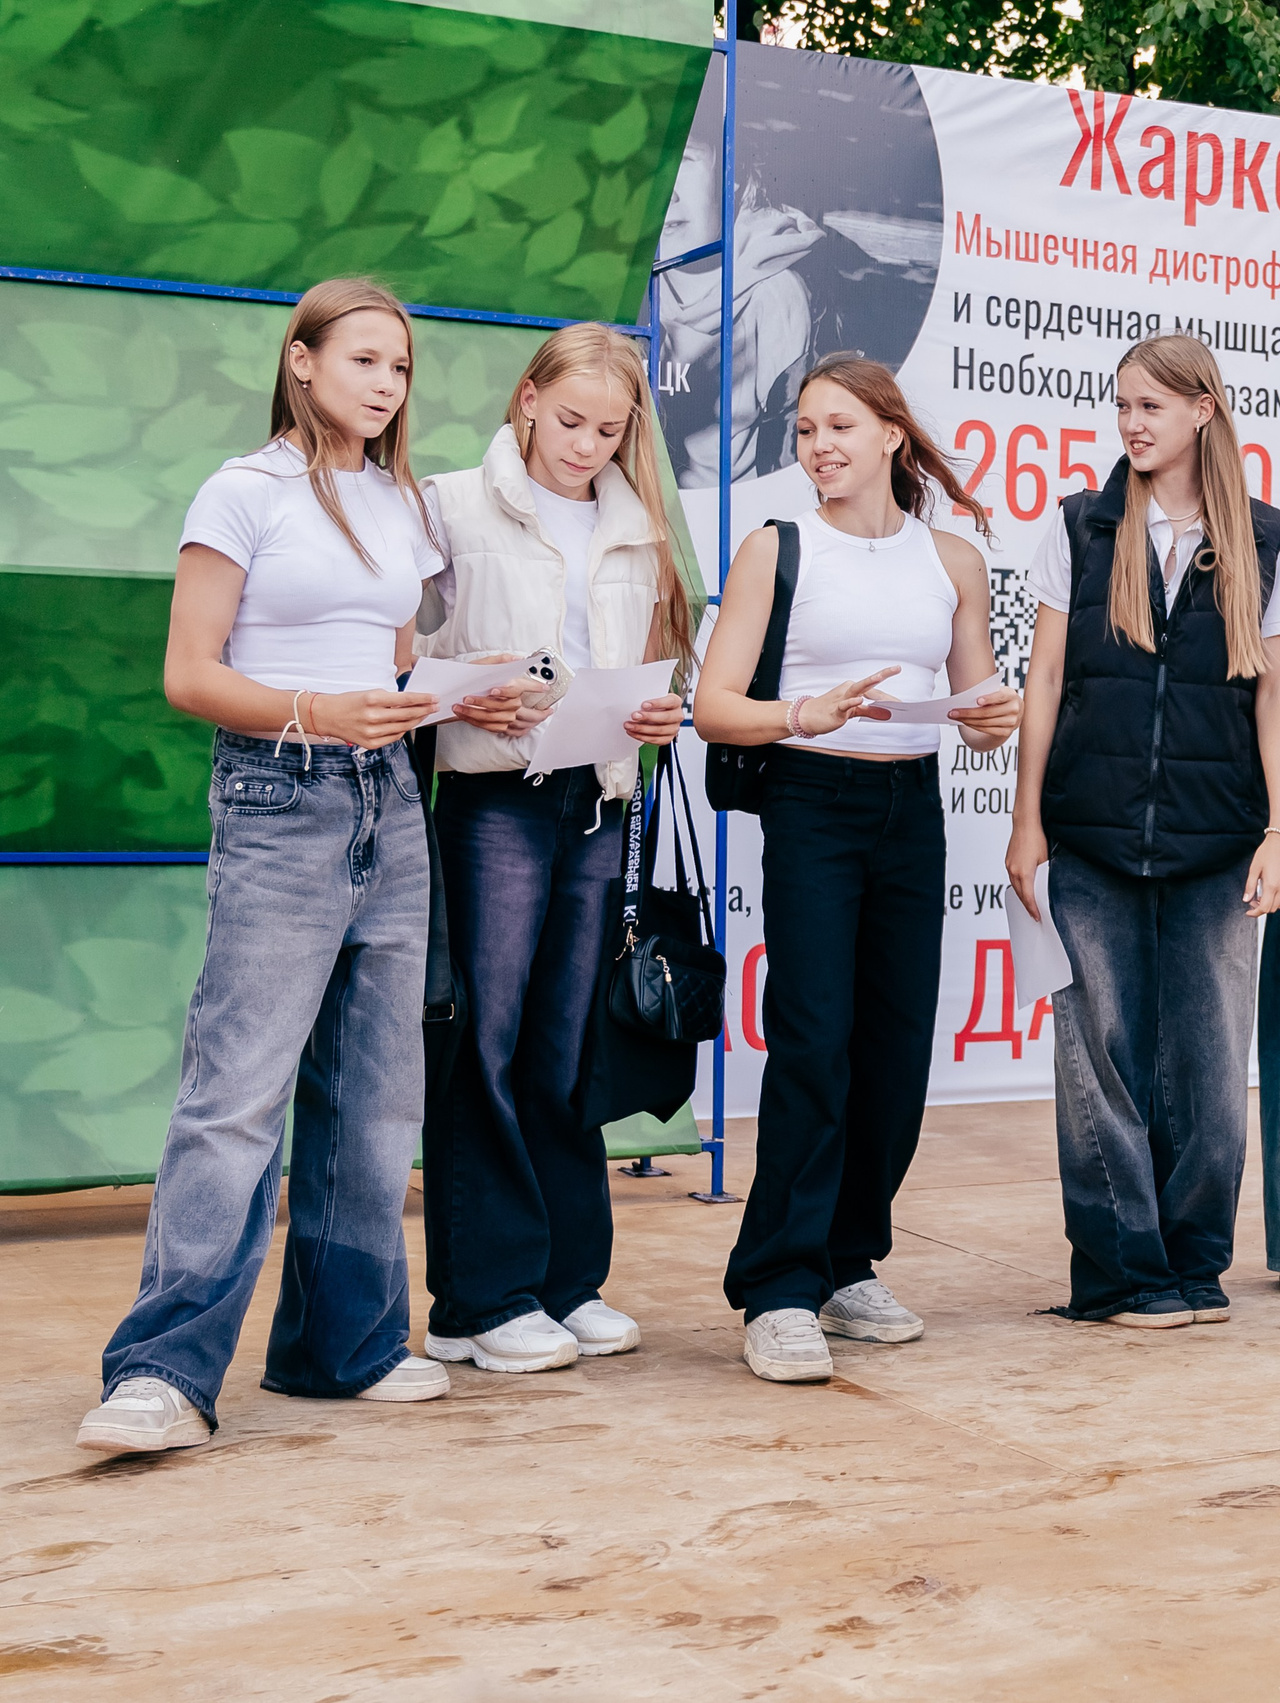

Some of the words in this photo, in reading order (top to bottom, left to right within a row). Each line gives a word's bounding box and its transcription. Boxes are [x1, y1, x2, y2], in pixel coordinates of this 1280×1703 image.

[954, 210, 1138, 275] Мышечная
[953, 291, 972, 324] и
[985, 294, 1161, 342] сердечная
[952, 345, 1115, 409] Необходи
[951, 419, 1099, 521] 265
[951, 786, 965, 814] и
